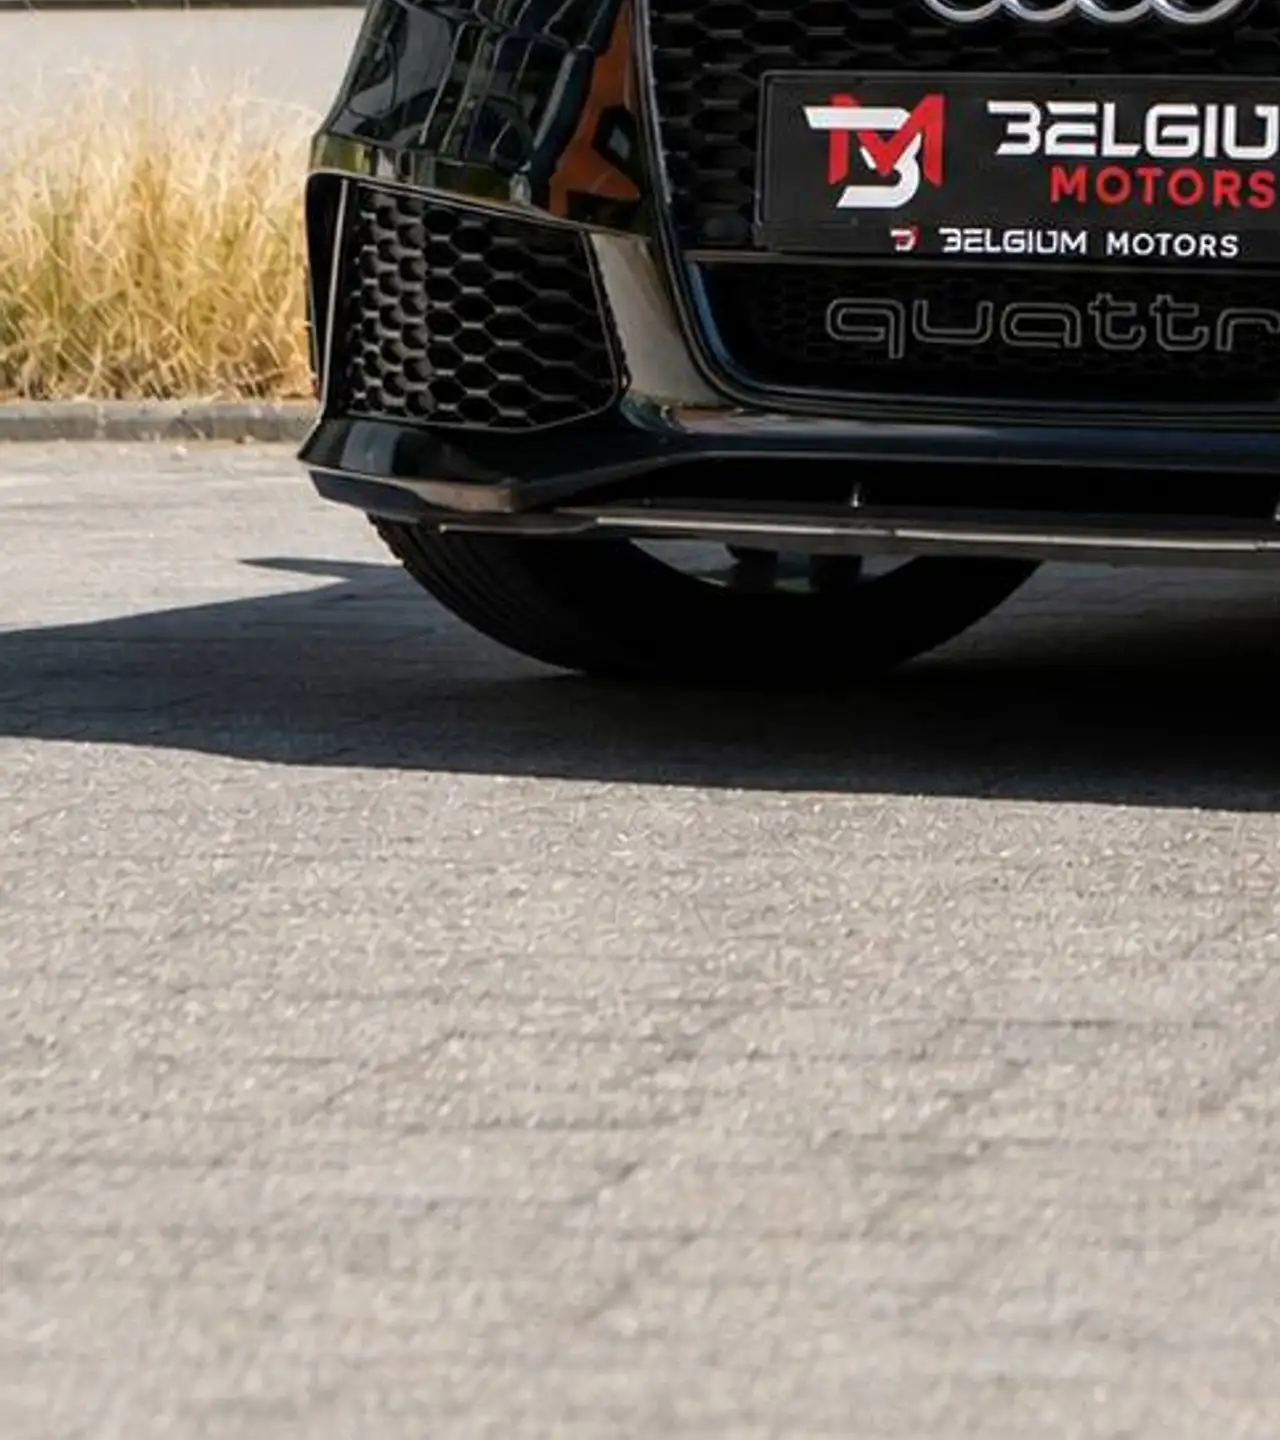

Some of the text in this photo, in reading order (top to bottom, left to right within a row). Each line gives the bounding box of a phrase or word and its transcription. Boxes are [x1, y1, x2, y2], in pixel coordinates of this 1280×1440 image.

[1050, 164, 1276, 209] MOTORS
[939, 227, 1087, 255] BELGIUM
[1106, 231, 1239, 258] MOTORS
